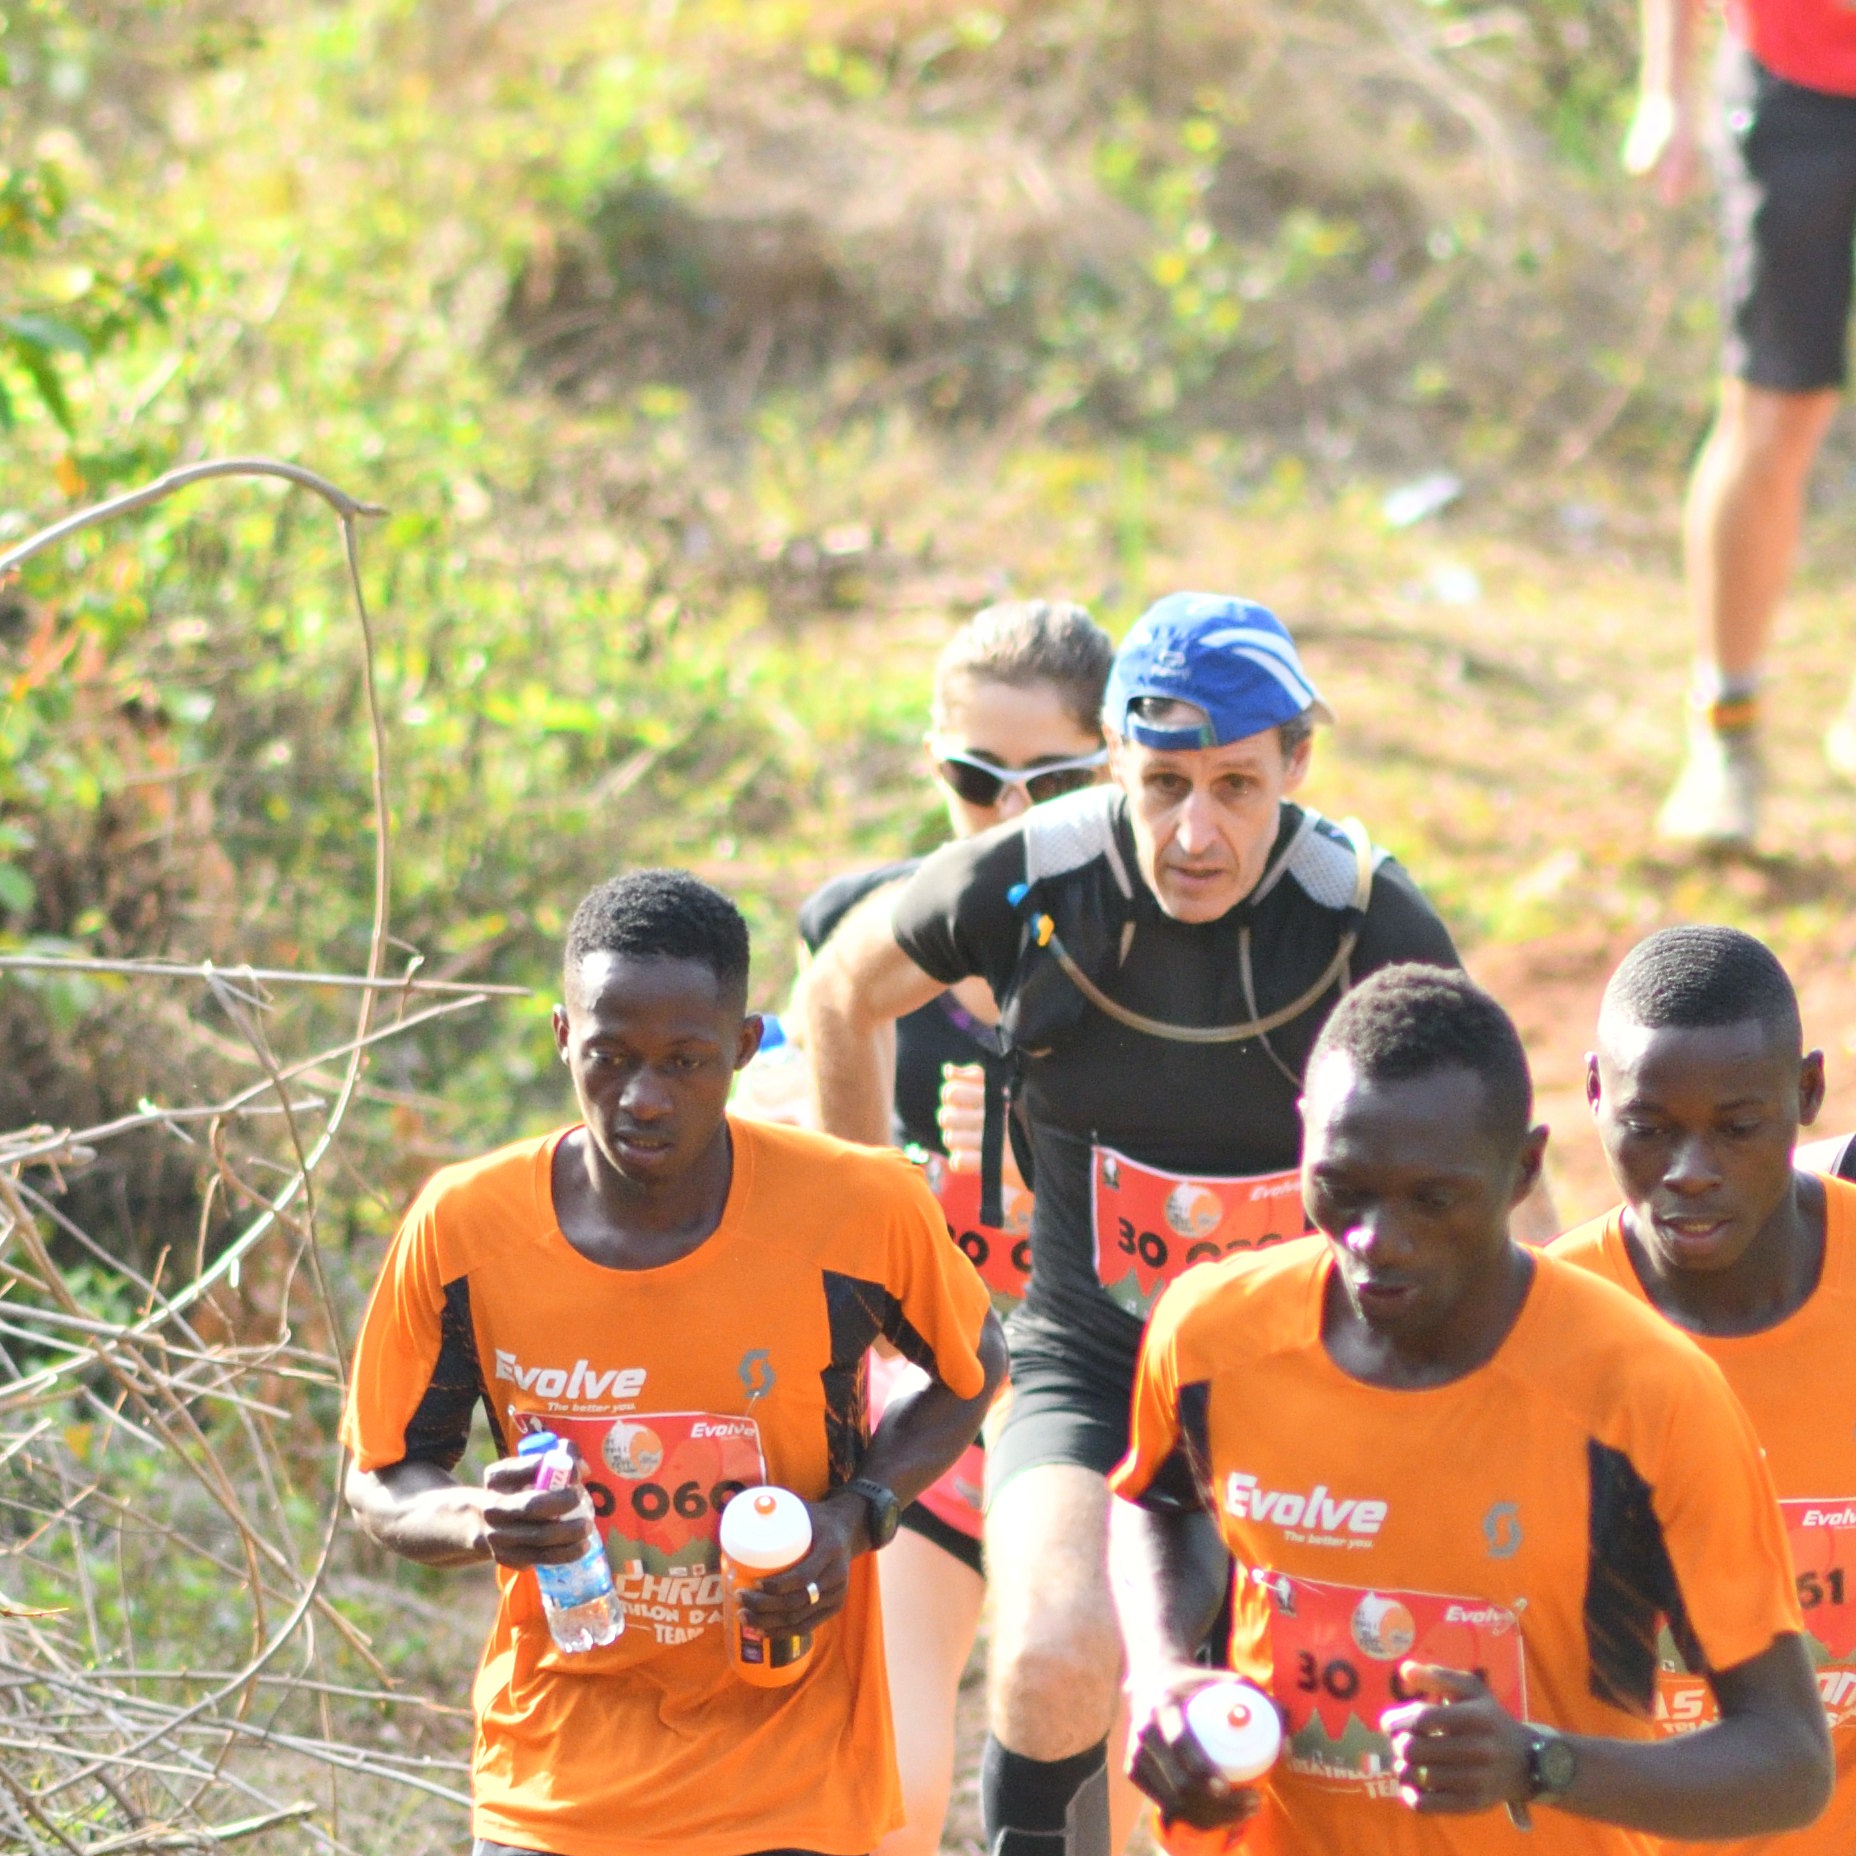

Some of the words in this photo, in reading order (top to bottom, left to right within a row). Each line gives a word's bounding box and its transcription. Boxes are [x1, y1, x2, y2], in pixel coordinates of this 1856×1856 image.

[1117, 1216, 1168, 1269] 30
[495, 1348, 648, 1400] Evolve
[547, 1402, 569, 1412] The
[572, 1402, 610, 1413] better
[690, 1422, 756, 1439] Evolve
[1226, 1471, 1388, 1533] Evolve
[1284, 1530, 1305, 1543] The
[1308, 1533, 1346, 1547] better
[616, 1574, 725, 1606] CHRO
[1298, 1649, 1359, 1702] 30
